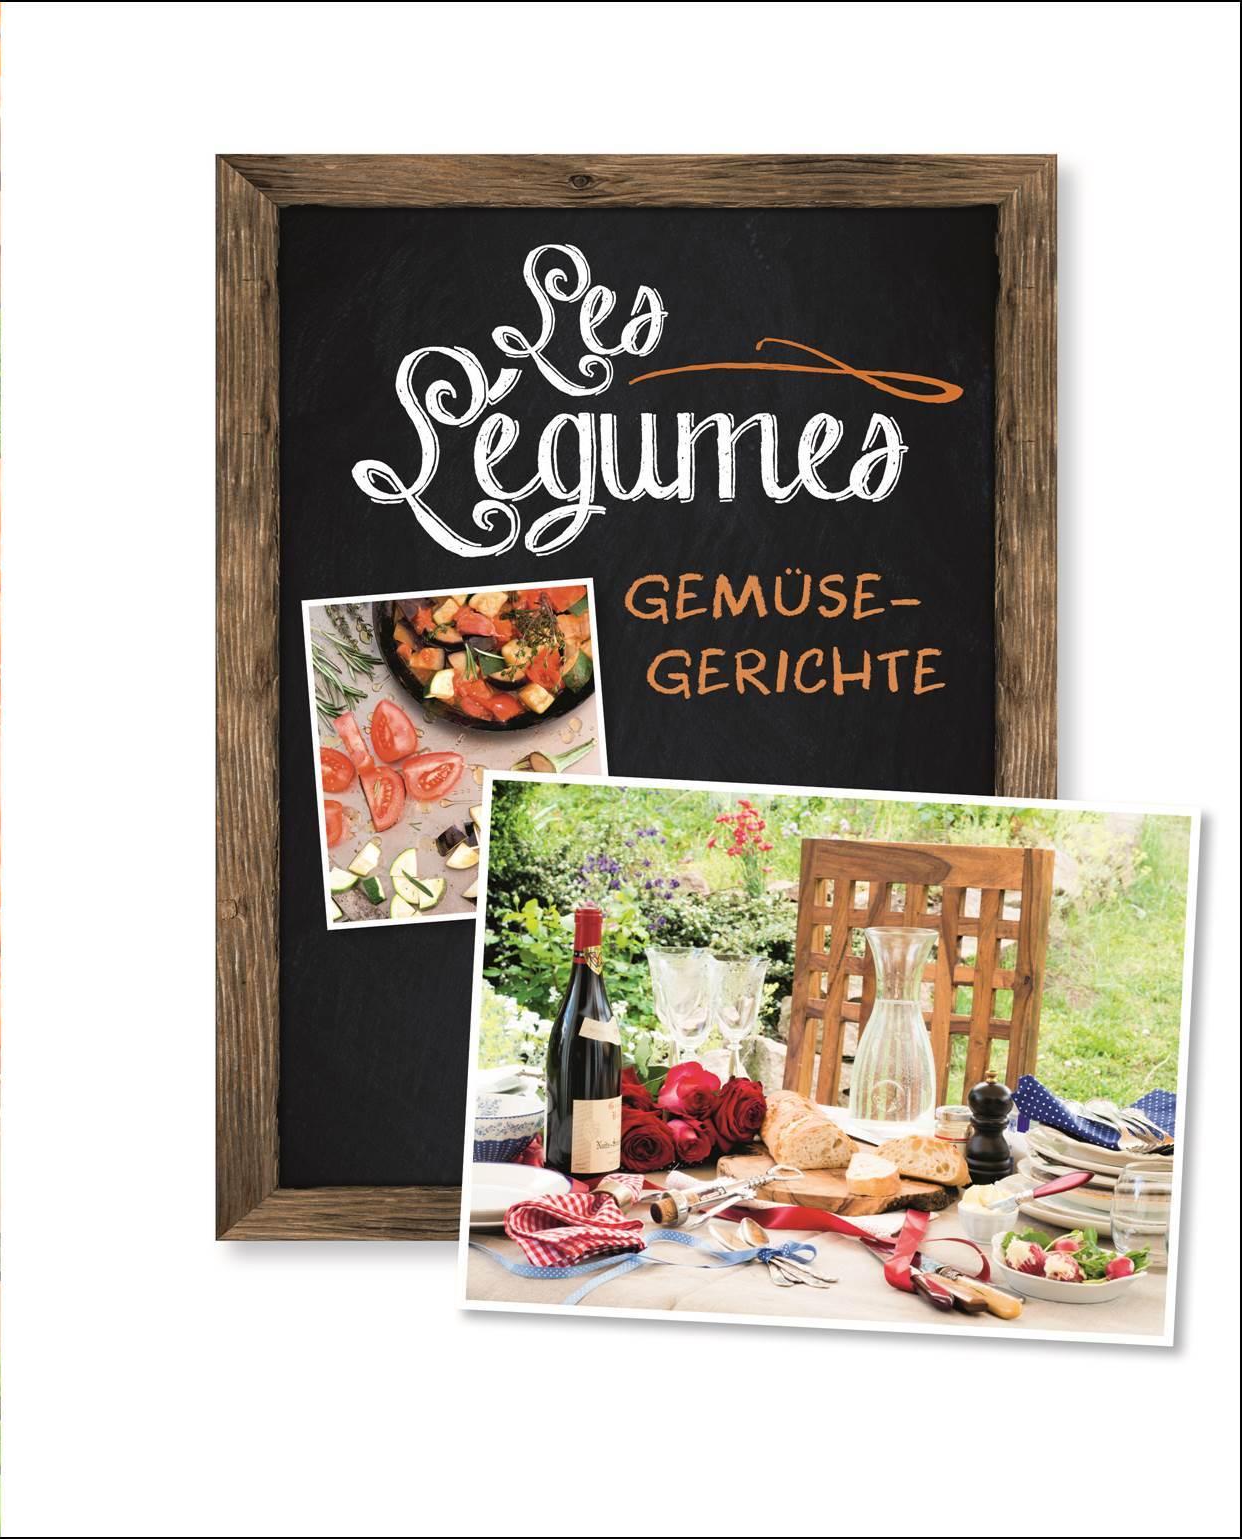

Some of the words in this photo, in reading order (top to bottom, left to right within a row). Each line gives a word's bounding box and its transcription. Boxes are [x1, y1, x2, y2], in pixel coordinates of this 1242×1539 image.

[491, 243, 668, 396] Les
[351, 345, 909, 557] Légumes
[624, 567, 921, 624] GEMÜSE-
[646, 646, 946, 698] GERICHTE
